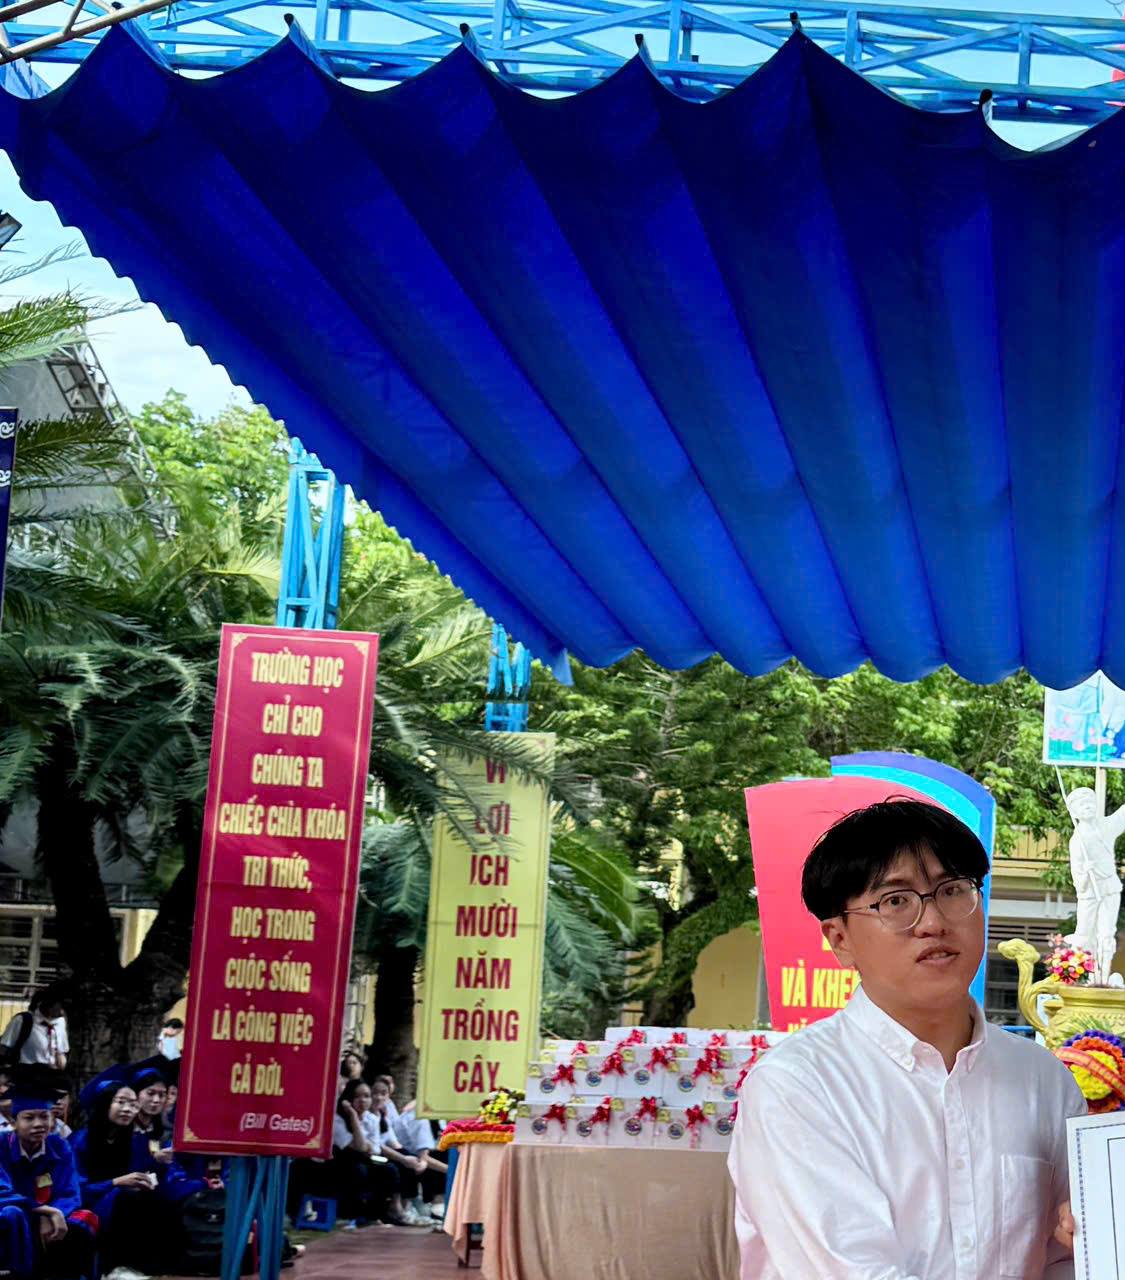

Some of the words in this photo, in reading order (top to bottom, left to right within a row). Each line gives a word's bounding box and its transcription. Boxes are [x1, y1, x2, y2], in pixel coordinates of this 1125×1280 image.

[251, 646, 311, 685] TRƯỜNG
[312, 656, 344, 693] HỌC
[262, 694, 291, 734] CHỈ
[291, 705, 323, 737] CHO
[251, 748, 304, 787] CHÚNG
[307, 757, 323, 787] TA
[219, 794, 265, 835] CHIẾC
[267, 800, 302, 838] CHÌA
[305, 802, 346, 840] KHÓA
[242, 855, 267, 887] TRI
[270, 851, 313, 893] THỨC,
[230, 906, 262, 945] HỌC
[266, 908, 316, 941] TRONG
[455, 897, 518, 938] MƯỜI
[225, 952, 267, 996] CUỘC
[269, 950, 312, 993] SỐNG
[455, 950, 512, 989] NĂM
[781, 959, 807, 1008] VÀ
[211, 1003, 231, 1040] LÀ
[234, 1004, 277, 1043] CÔNG
[280, 1008, 314, 1051] VIỆC
[441, 998, 520, 1042] TRỒNG
[230, 1053, 252, 1095] CẢ
[253, 1056, 284, 1096] ĐỜI.
[453, 1054, 501, 1093] CÂY
[240, 1112, 267, 1132] (Bill
[270, 1113, 315, 1136] Gates)
